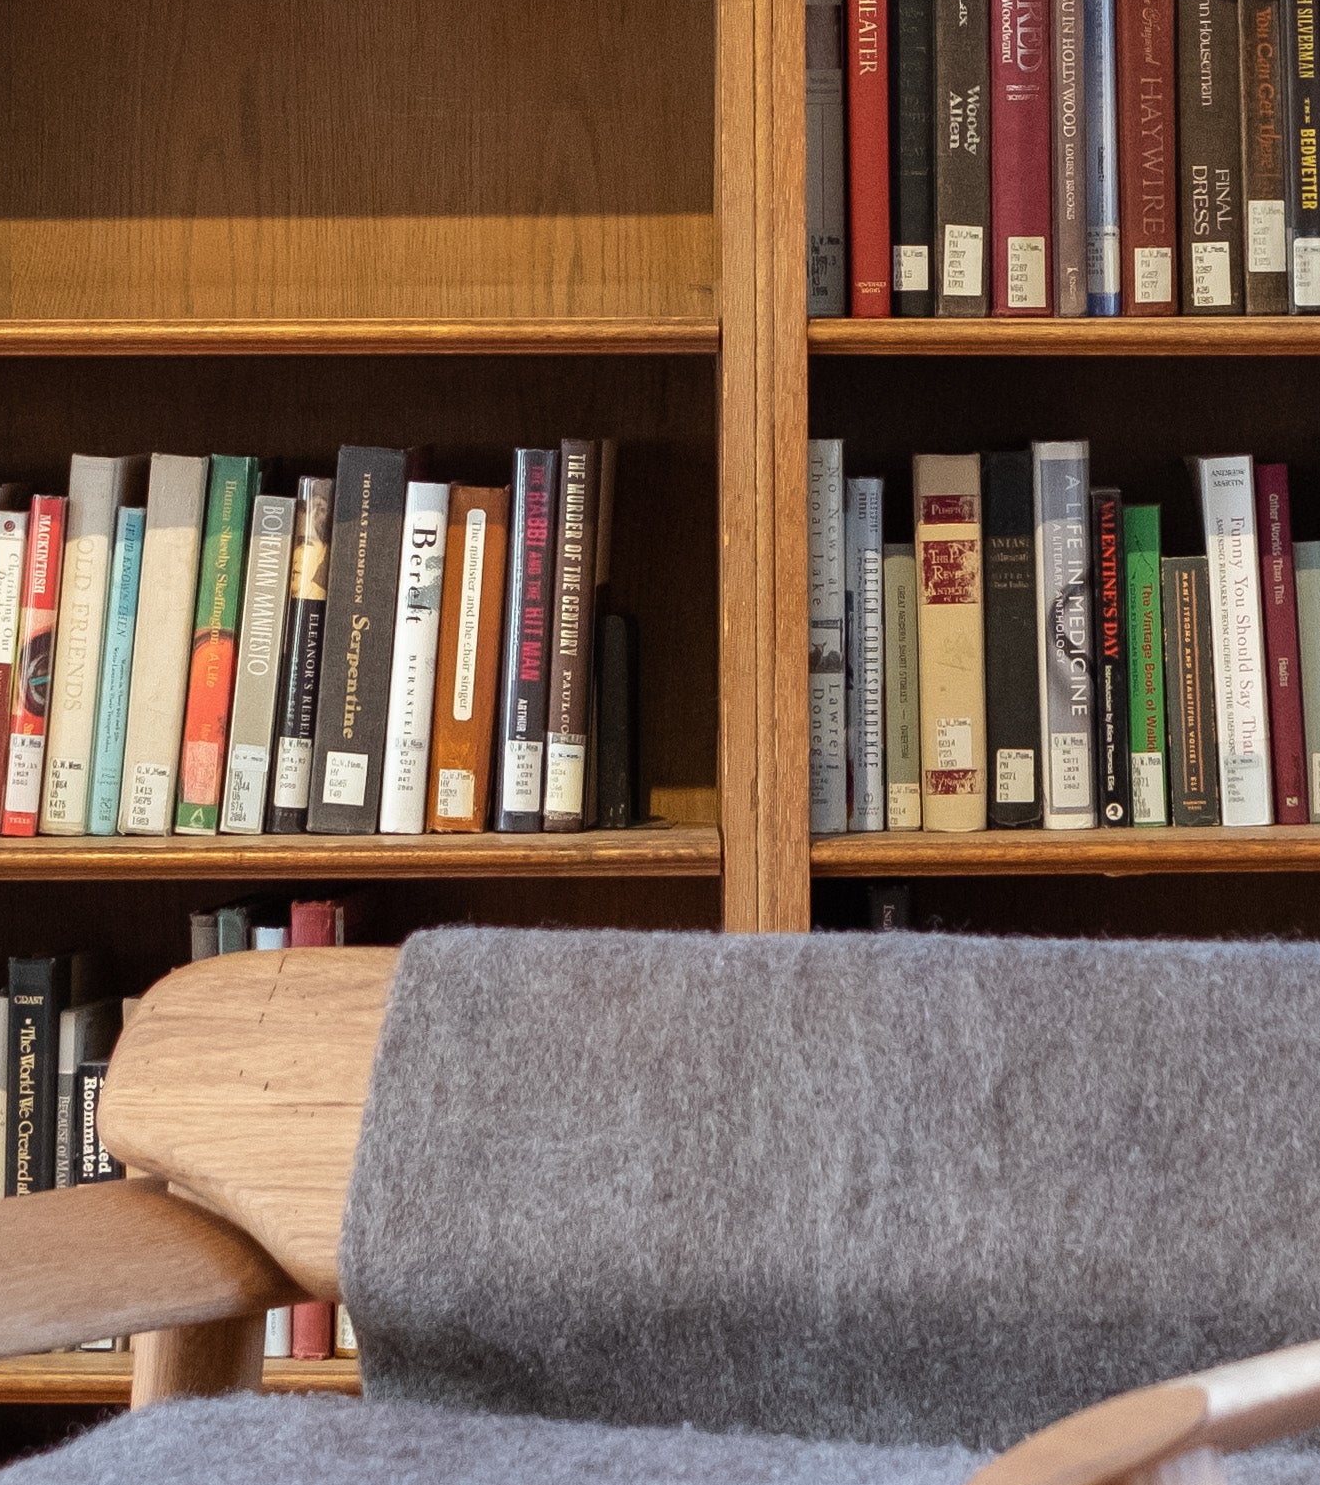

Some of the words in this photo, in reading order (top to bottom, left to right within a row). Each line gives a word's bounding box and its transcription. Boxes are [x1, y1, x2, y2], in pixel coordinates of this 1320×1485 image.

[1198, 20, 1214, 106] Houseman
[1297, 8, 1315, 78] SILVERMAN
[1192, 165, 1208, 235] DRESS
[1215, 169, 1231, 230] FINAL
[1064, 475, 1080, 490] A
[1066, 503, 1082, 549] LIFE
[1068, 560, 1084, 585] IN
[1069, 596, 1088, 717] MEDICINE
